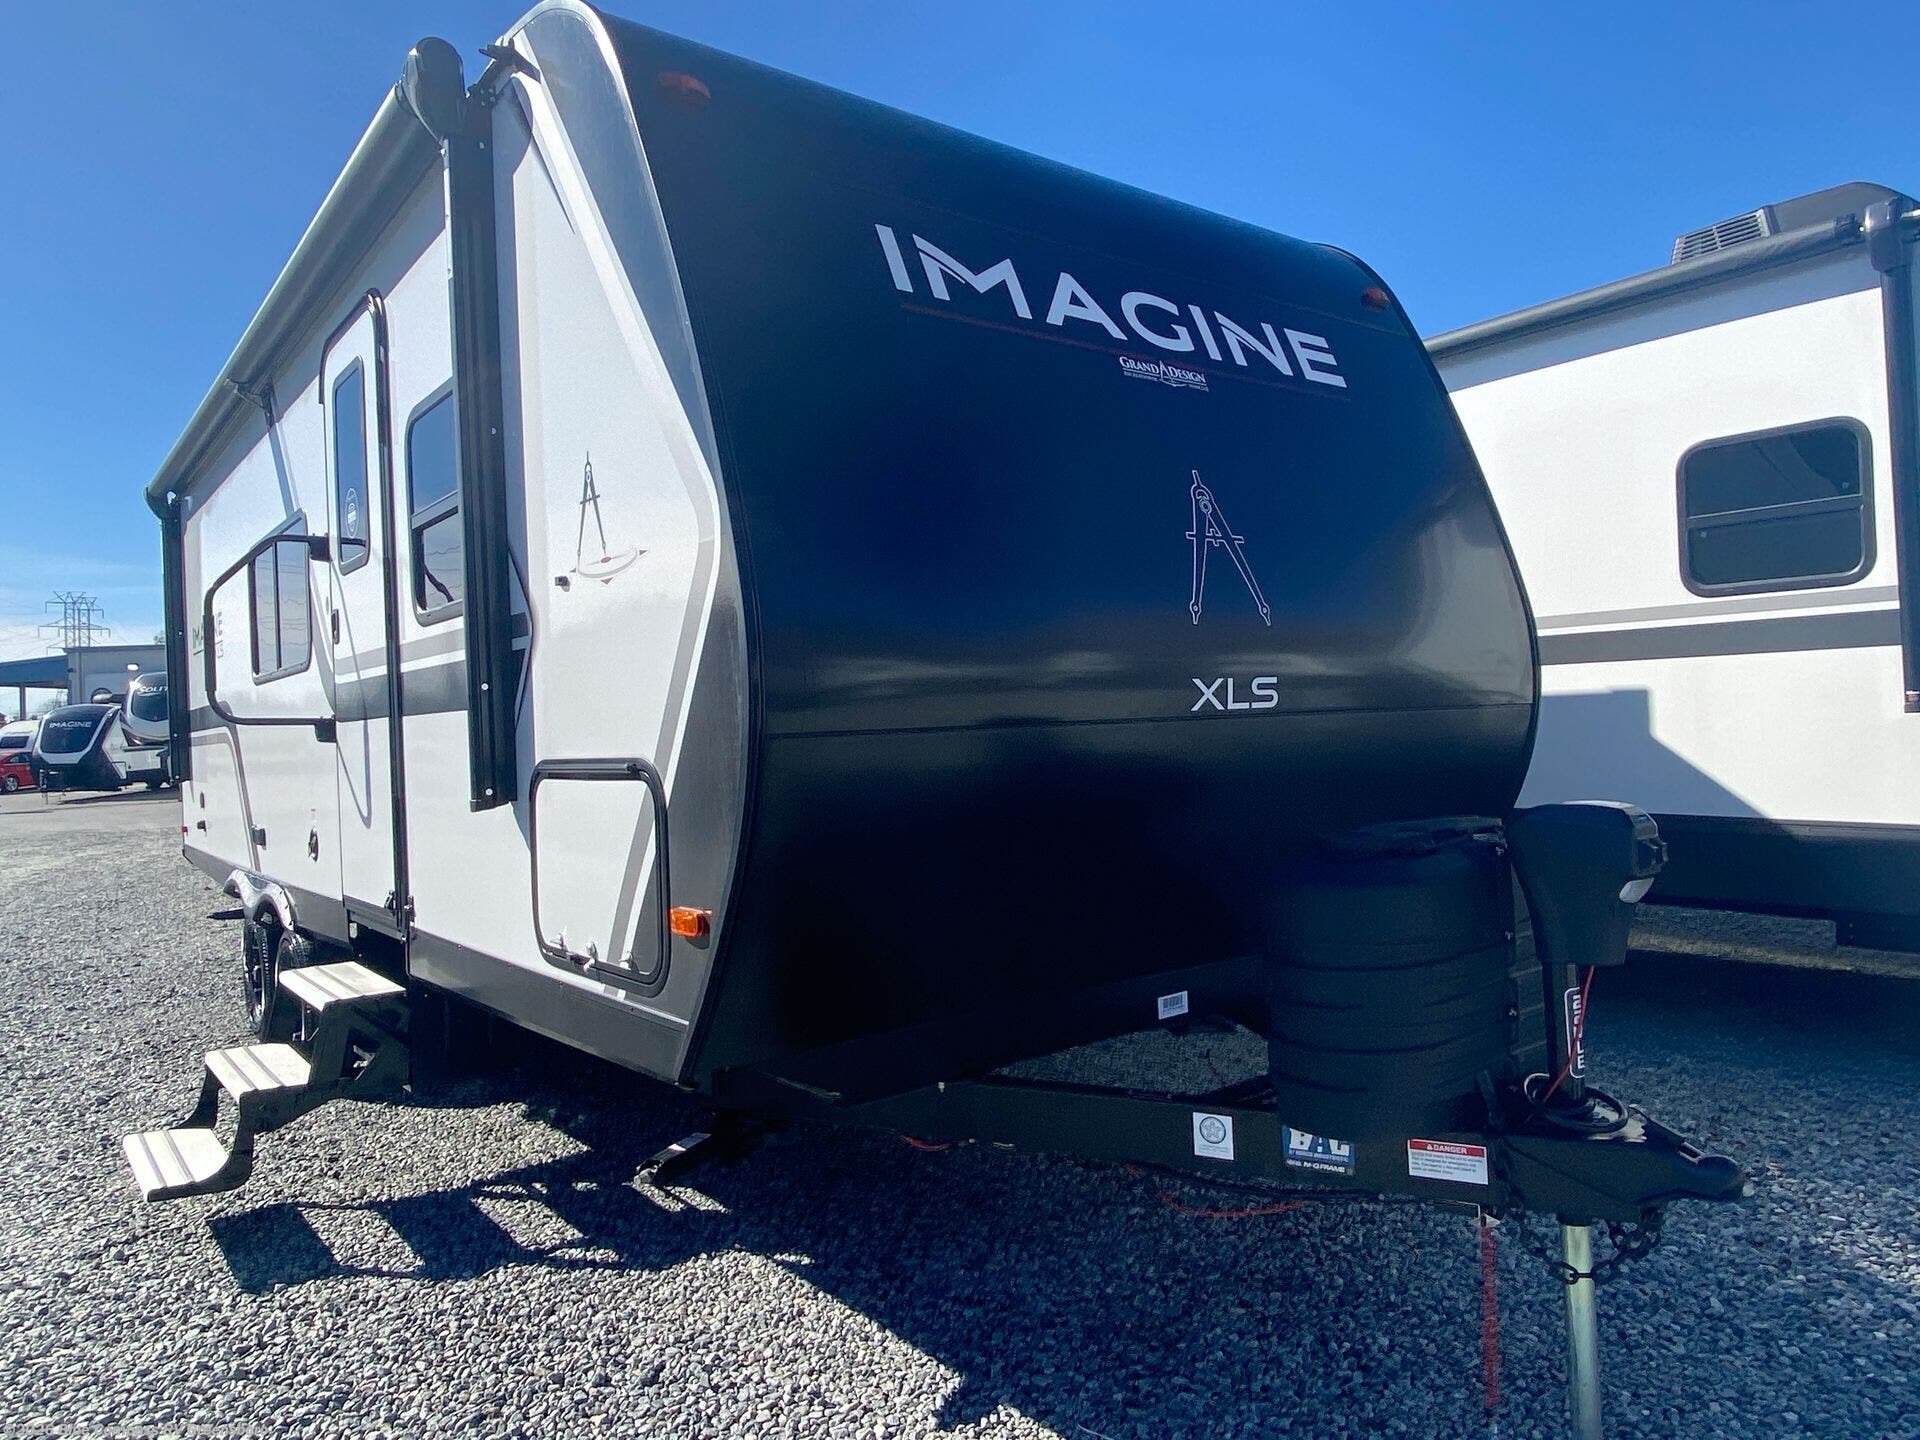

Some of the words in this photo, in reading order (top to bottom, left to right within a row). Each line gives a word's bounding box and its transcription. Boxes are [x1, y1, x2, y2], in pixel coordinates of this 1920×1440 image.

[874, 223, 1347, 388] IMAGINE
[1119, 356, 1159, 373] GRAND
[1191, 676, 1279, 712] XLS
[48, 721, 92, 729] IMAGINE
[1433, 1144, 1468, 1155] DANGER
